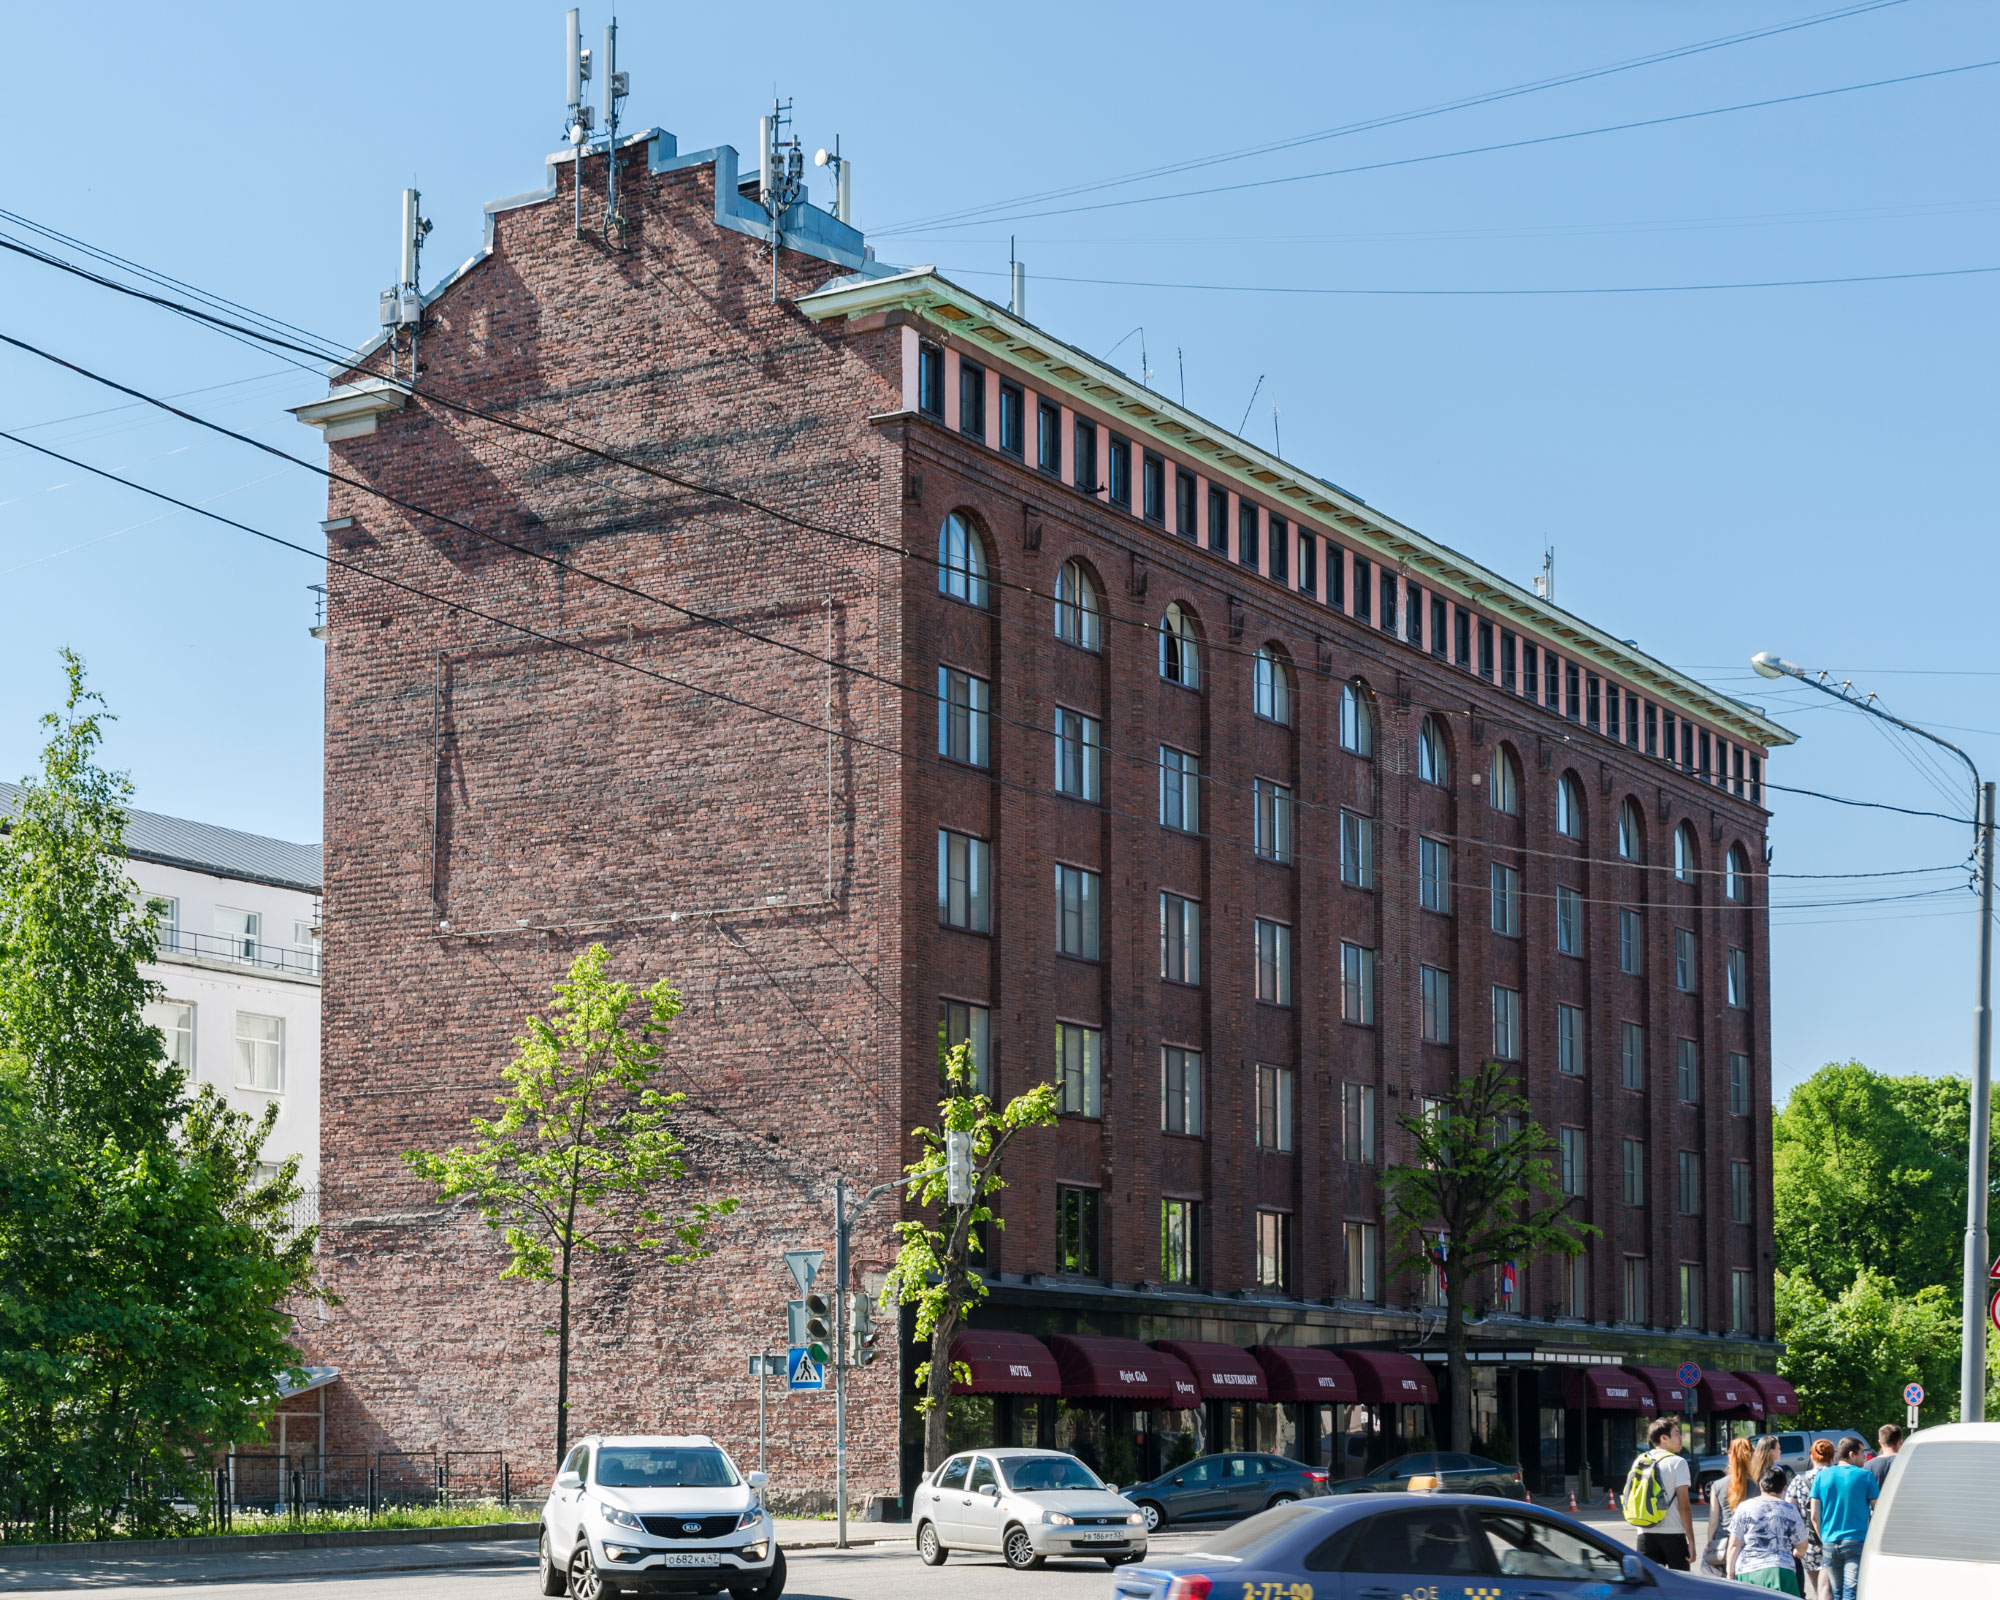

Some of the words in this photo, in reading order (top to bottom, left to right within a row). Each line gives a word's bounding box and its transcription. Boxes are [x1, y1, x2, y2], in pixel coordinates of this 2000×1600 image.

[1009, 1365, 1032, 1377] HOTEL
[1119, 1370, 1135, 1383] Night
[1135, 1371, 1148, 1382] Club
[1212, 1373, 1224, 1384] BAR
[1224, 1374, 1257, 1385] RESTAURANT
[1318, 1377, 1335, 1387] HOTEL
[1402, 1379, 1418, 1390] HOTEL
[1175, 1380, 1195, 1394] Vyborg
